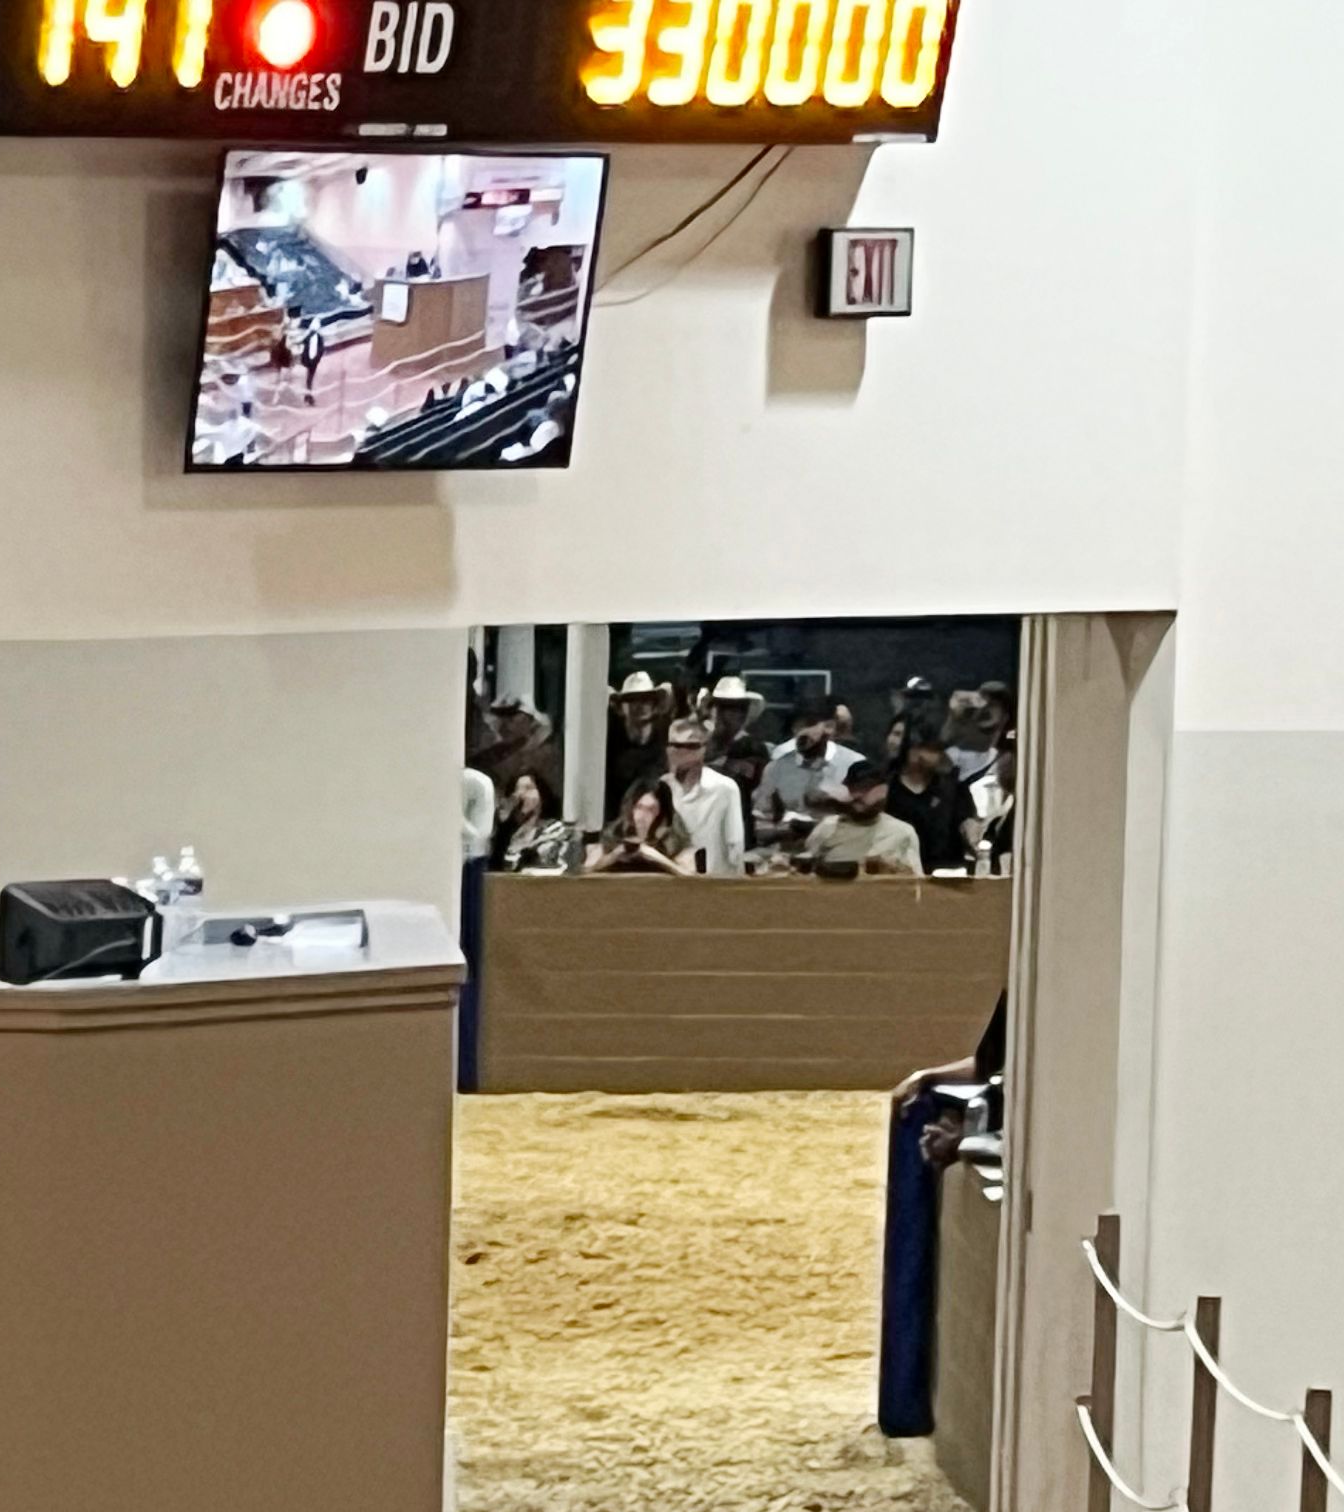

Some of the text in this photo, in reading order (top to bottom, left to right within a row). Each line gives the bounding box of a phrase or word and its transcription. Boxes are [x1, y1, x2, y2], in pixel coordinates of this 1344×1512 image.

[363, 0, 455, 74] BID
[580, 0, 946, 107] 330000
[213, 71, 342, 111] CHANGES
